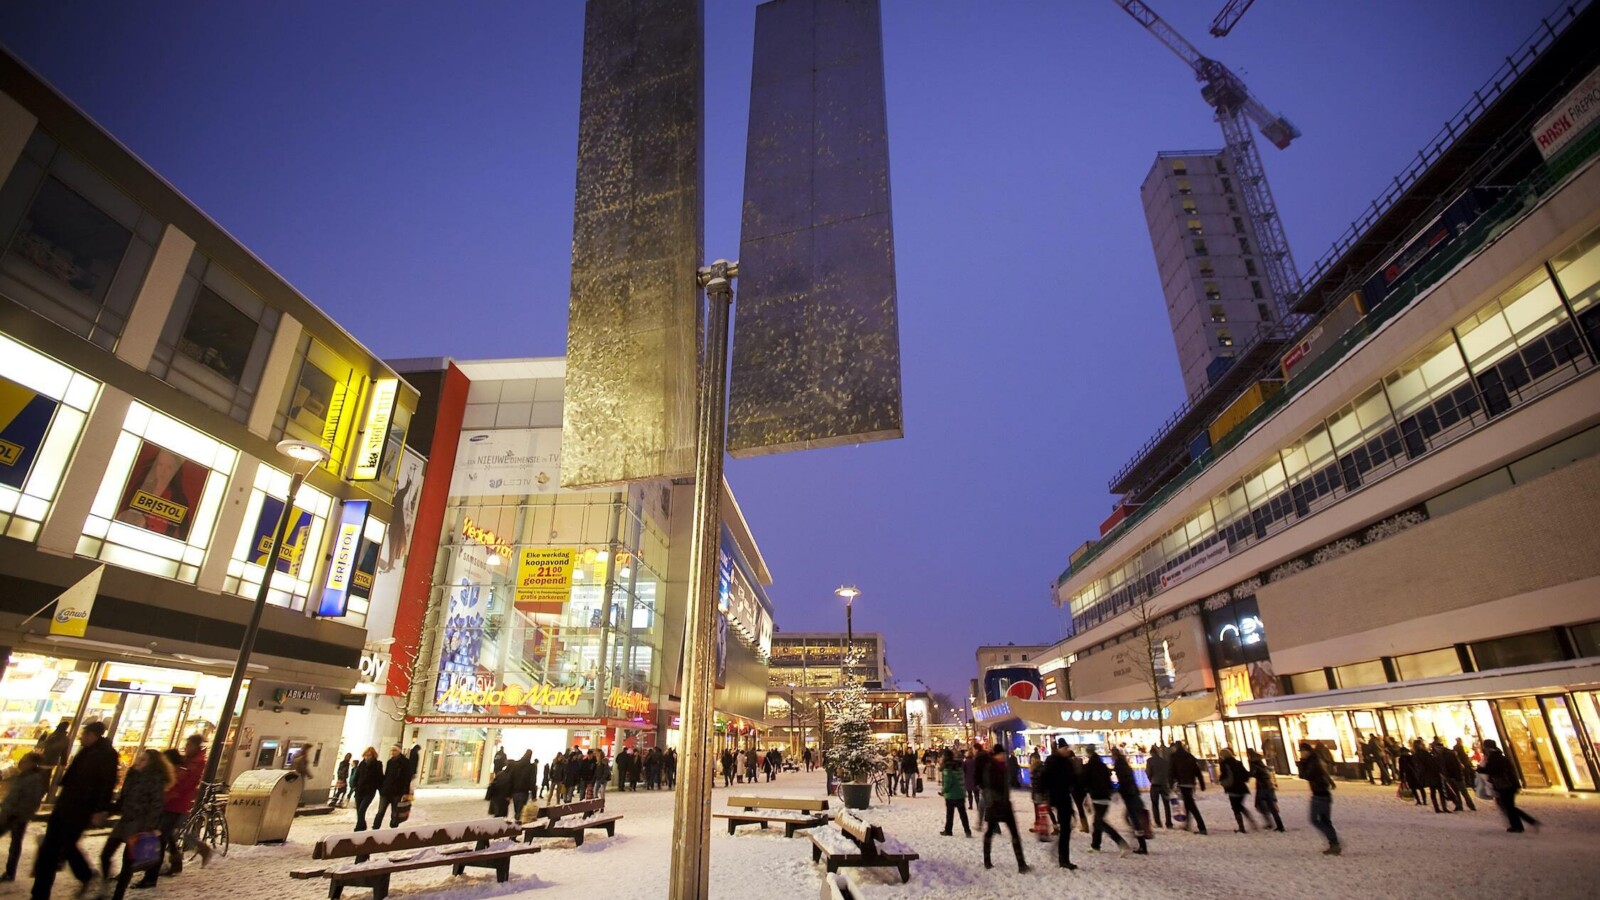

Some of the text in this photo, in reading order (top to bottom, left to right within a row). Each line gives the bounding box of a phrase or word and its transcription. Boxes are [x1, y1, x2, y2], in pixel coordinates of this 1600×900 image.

[1537, 115, 1572, 150] RASK
[477, 454, 508, 465] NIEUWE
[510, 455, 541, 464] DIMENSIE
[549, 453, 560, 462] TV
[137, 496, 182, 519] BRISTOL
[262, 540, 294, 558] BRTOL
[542, 551, 570, 559] werkdag
[333, 530, 355, 583] BRISTOL
[525, 558, 570, 567] koopavond
[355, 572, 370, 585] ISTOL
[523, 576, 567, 586] geopend!
[537, 593, 567, 601] parkeren!
[436, 683, 582, 707] Media Markt
[1060, 706, 1171, 724] verse patat
[233, 798, 262, 807] AFVAL
